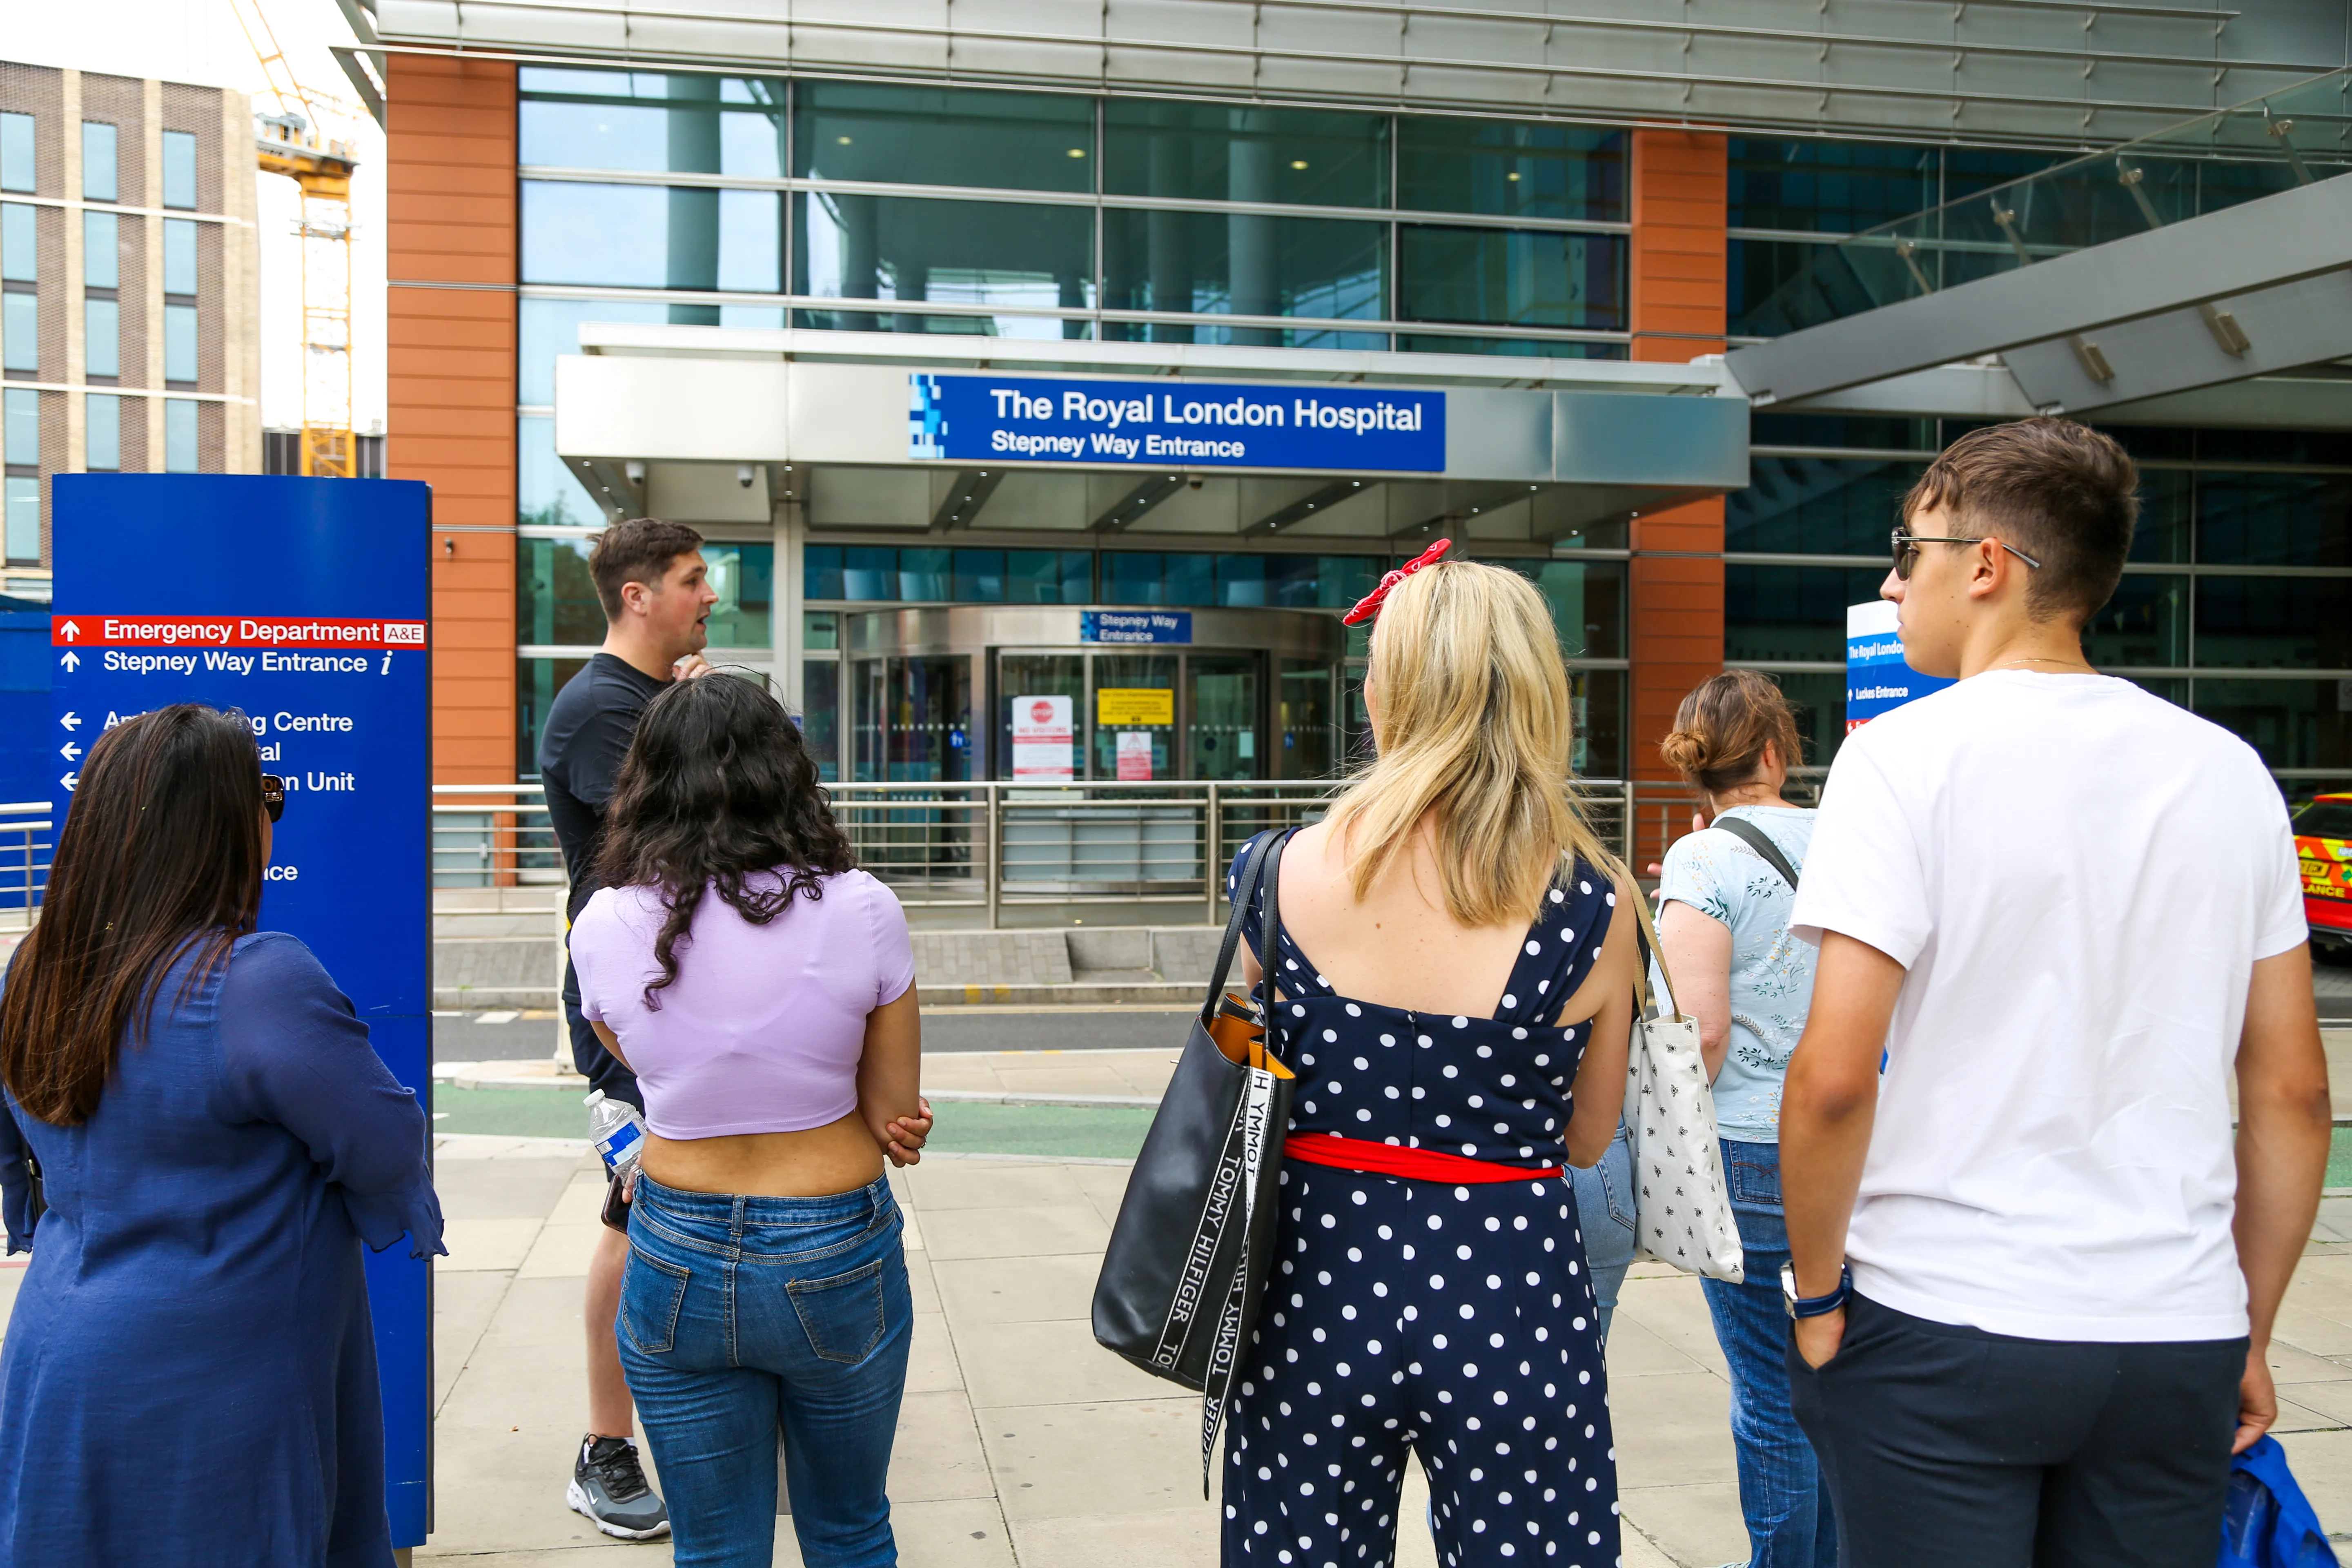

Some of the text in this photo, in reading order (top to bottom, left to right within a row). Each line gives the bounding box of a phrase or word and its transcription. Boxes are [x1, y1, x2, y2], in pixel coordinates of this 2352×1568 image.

[990, 389, 1422, 436] The Royal London Hospital
[991, 429, 1245, 459] Stepney Way Entrance
[104, 619, 421, 645] Emergency Department A&E
[1099, 613, 1178, 630] Stepney Way
[1099, 629, 1154, 642] Entrance
[1849, 645, 1859, 659] The
[1859, 642, 1876, 660] Royal
[104, 650, 198, 676] Stepney
[203, 651, 255, 676] Way
[262, 651, 368, 673] Entrance
[1875, 686, 1909, 699] Entrance
[274, 711, 353, 732] Centre
[307, 771, 355, 791] Unit
[2302, 883, 2345, 898] LANCE
[1173, 1156, 1241, 1323] TOMMY HILFIGER
[1212, 1303, 1240, 1375] TOMMY
